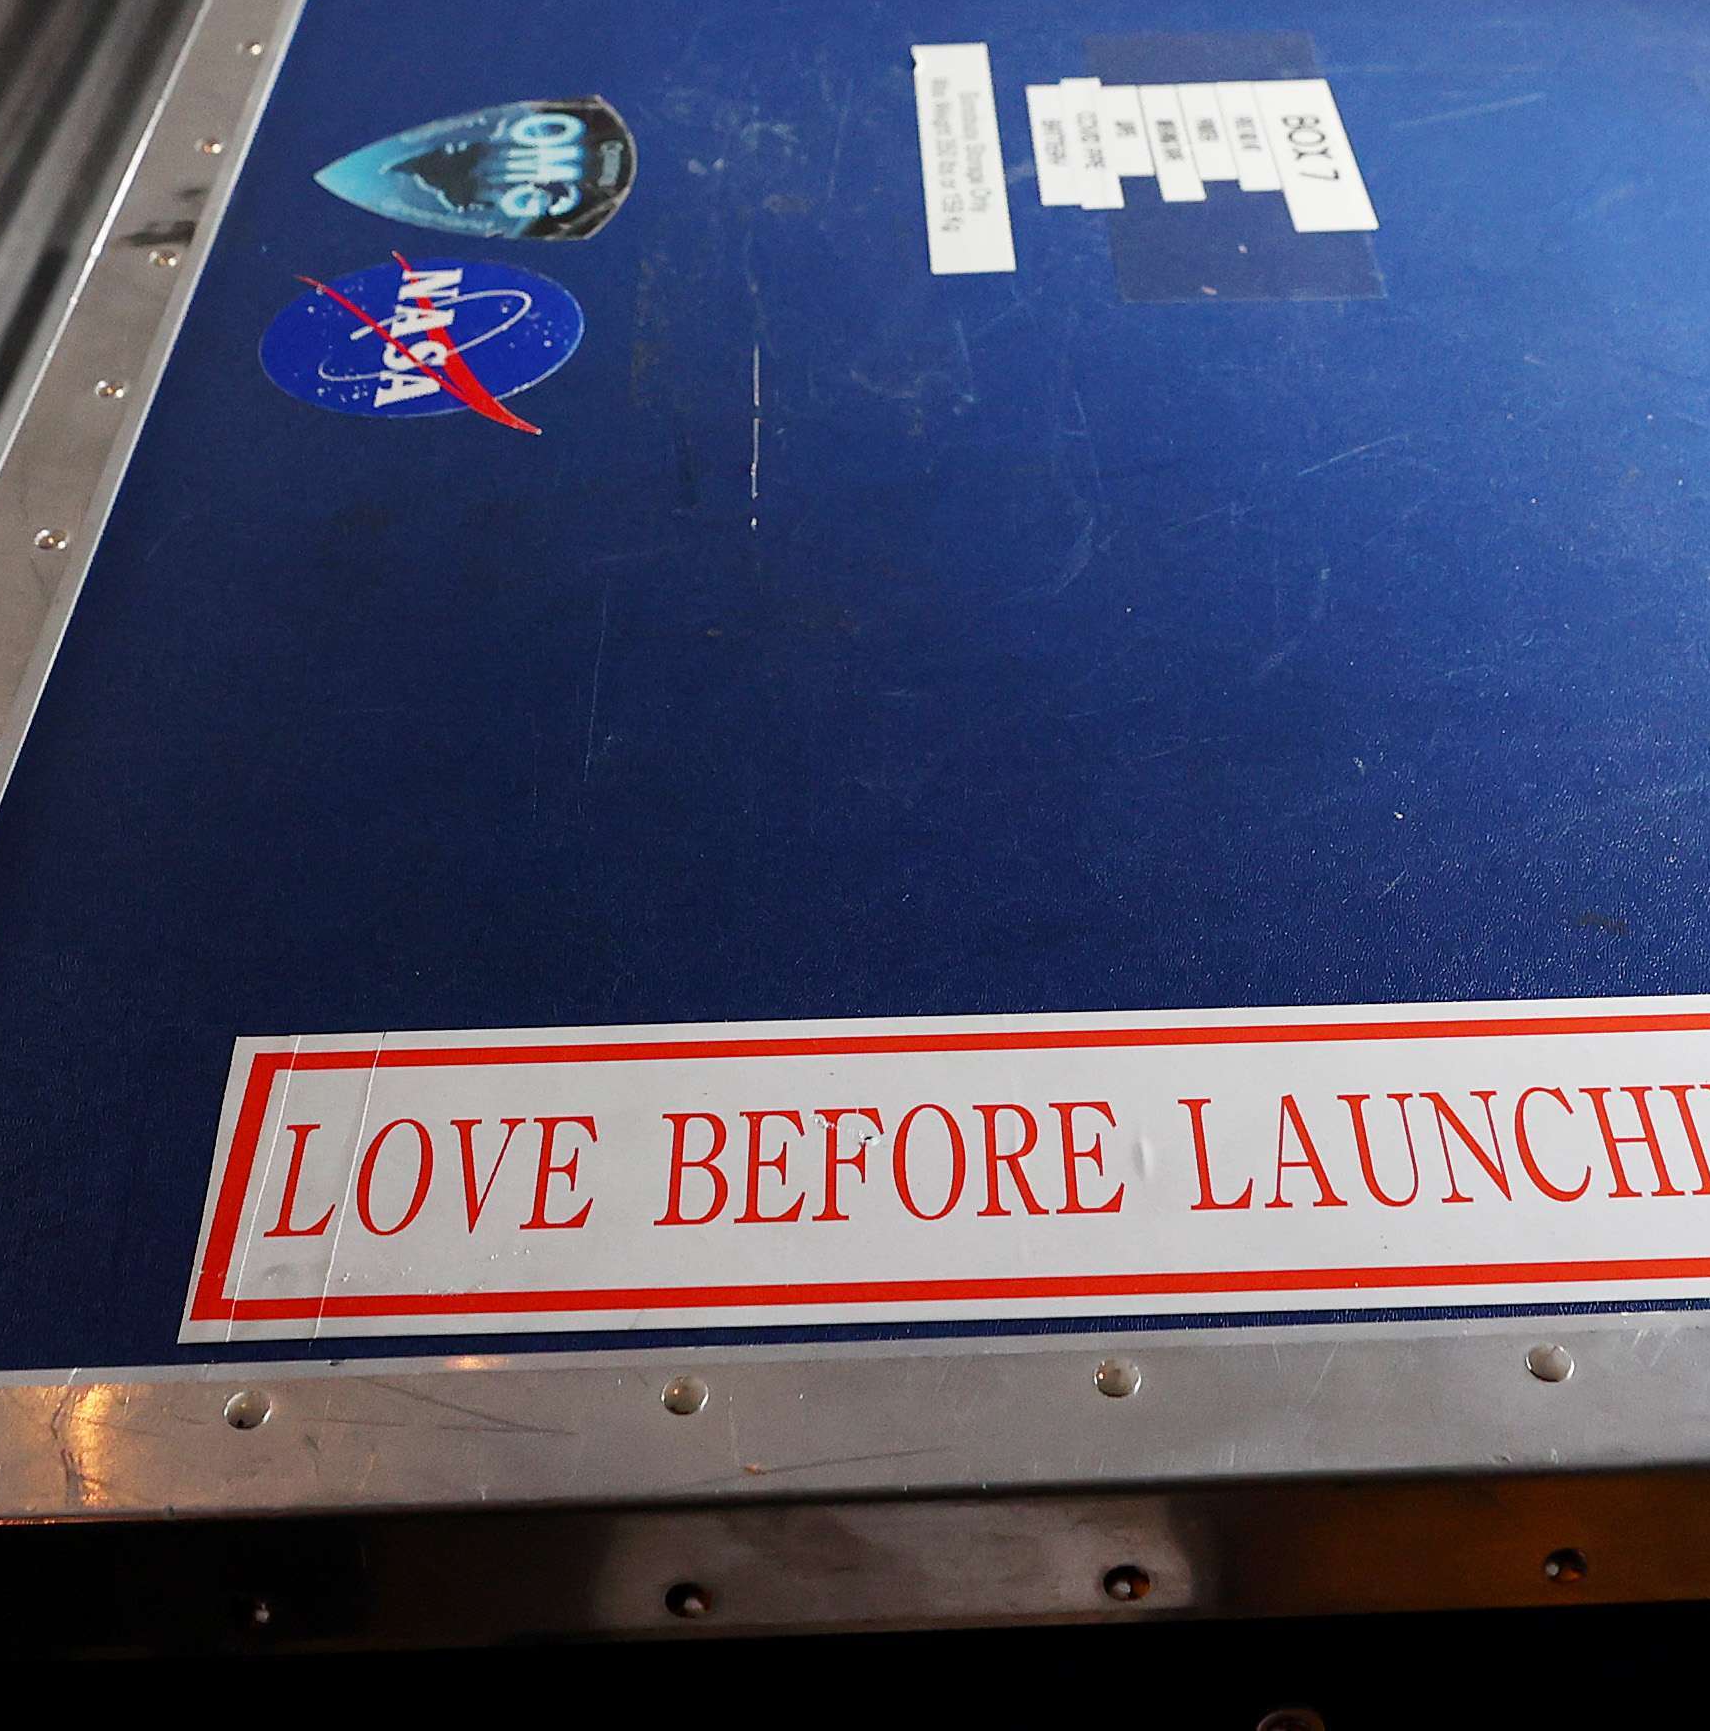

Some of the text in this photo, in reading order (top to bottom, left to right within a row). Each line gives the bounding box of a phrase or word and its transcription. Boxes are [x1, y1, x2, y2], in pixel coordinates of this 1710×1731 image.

[499, 112, 583, 219] OMG
[1281, 115, 1339, 181] BOX 7
[373, 268, 464, 408] NASA
[264, 1113, 599, 1239] LOVE
[654, 1101, 1126, 1226] BEFORE
